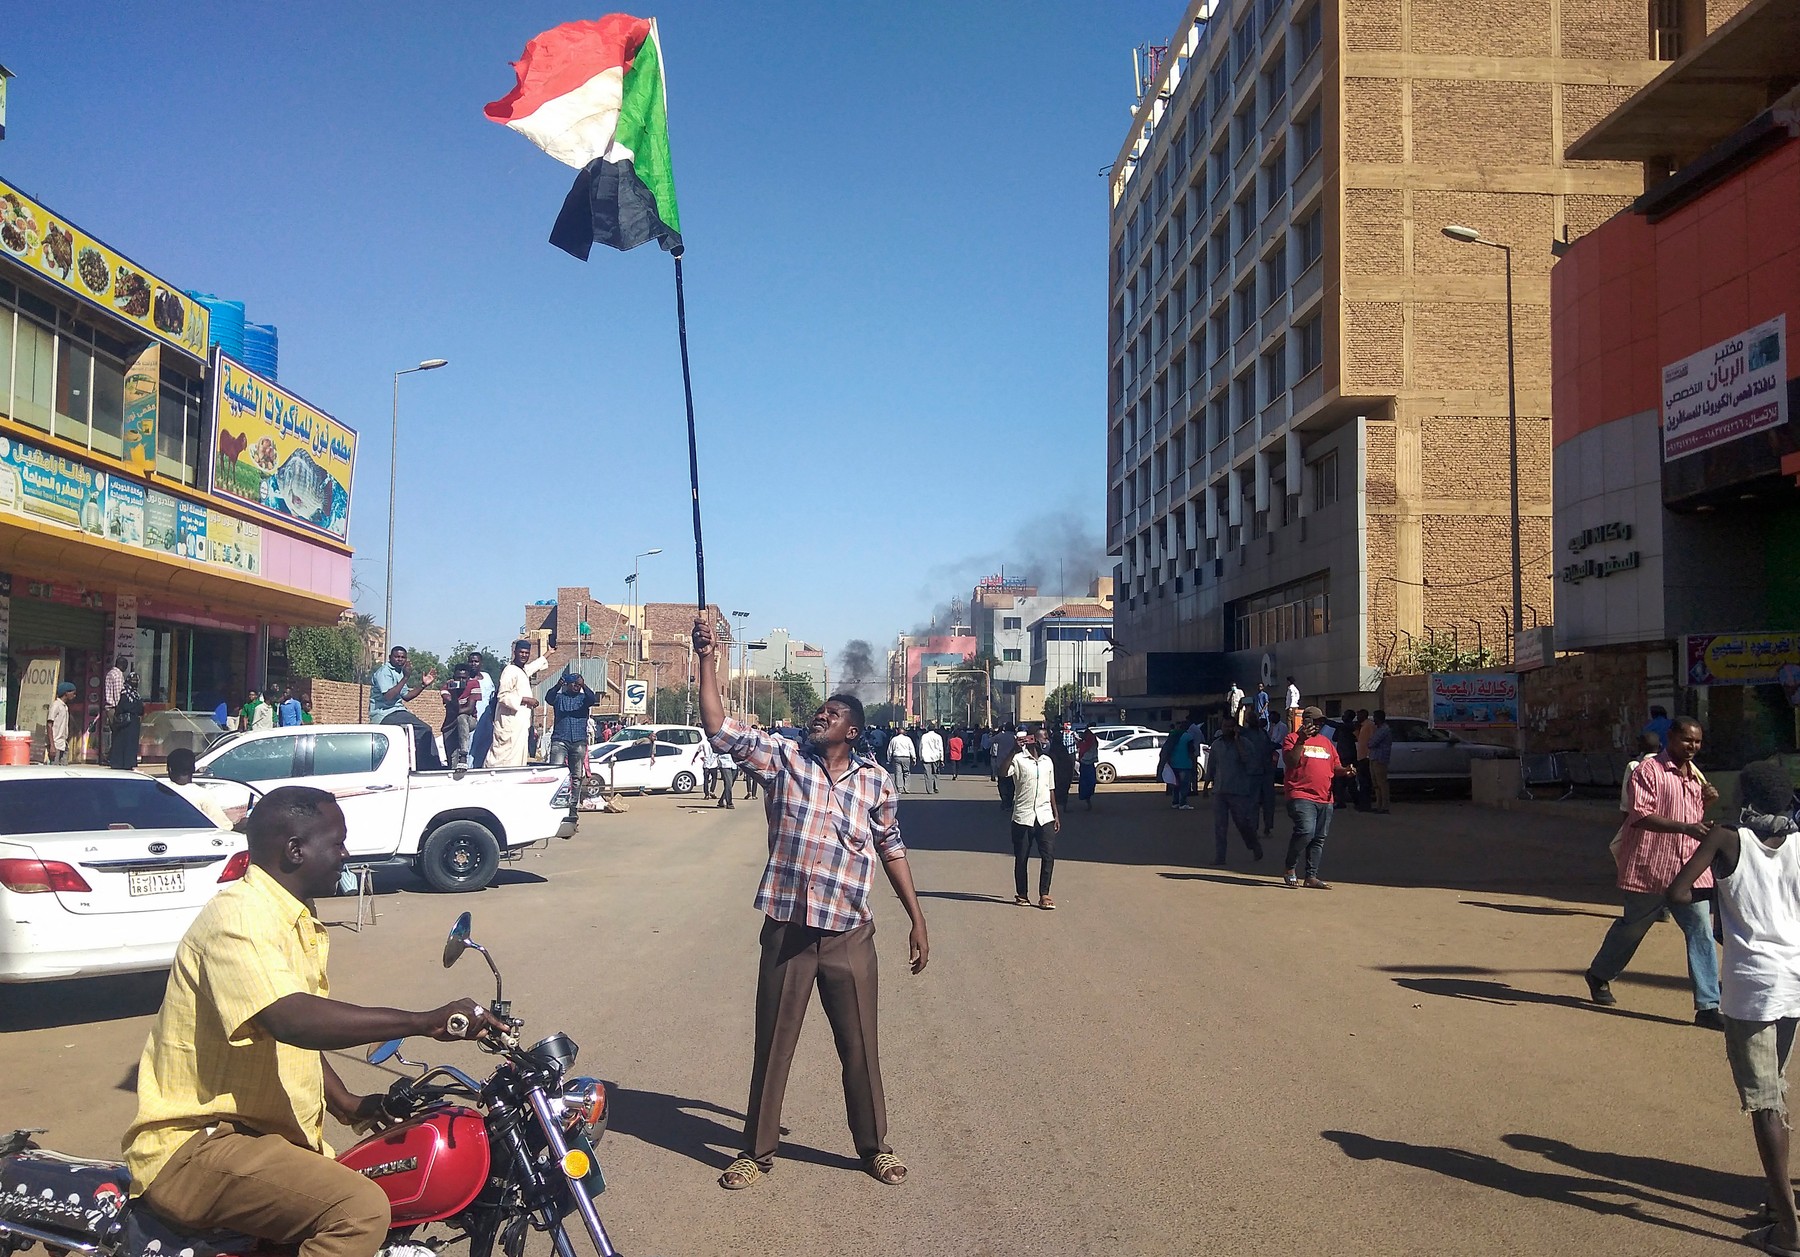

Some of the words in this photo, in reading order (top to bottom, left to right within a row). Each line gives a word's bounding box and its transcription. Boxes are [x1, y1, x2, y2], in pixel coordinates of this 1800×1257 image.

[1715, 340, 1743, 365] مختبر
[1707, 356, 1744, 392] الريان
[1666, 381, 1703, 410] التخصصي
[264, 391, 312, 443] للمأكولات
[312, 423, 329, 457] نون
[329, 434, 352, 465] مطعم
[23, 668, 56, 685] NOON
[1434, 679, 1474, 700] المحبة
[1477, 679, 1516, 699] وكالة
